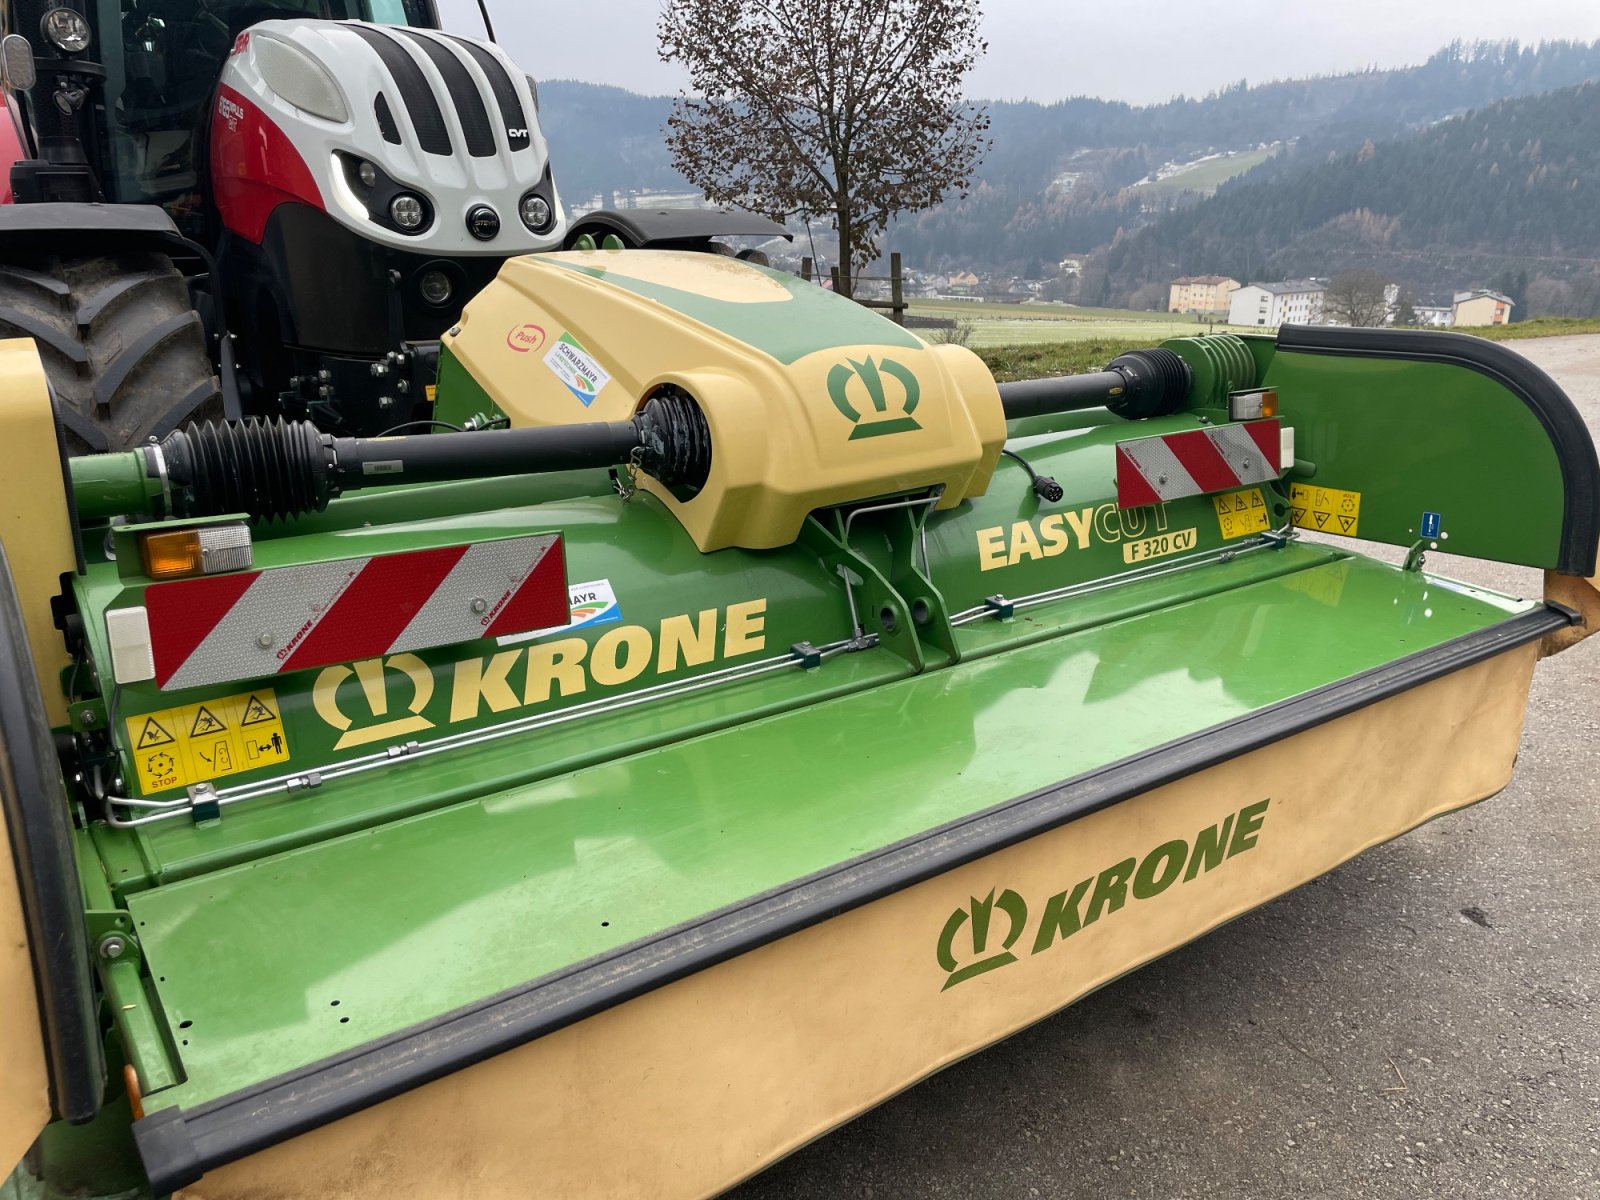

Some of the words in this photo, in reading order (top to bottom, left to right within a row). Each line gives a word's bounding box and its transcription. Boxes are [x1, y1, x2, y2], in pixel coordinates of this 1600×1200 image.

[508, 128, 528, 138] CVT
[515, 331, 537, 345] Push
[558, 343, 598, 384] SCHWARZMAYR
[1131, 547, 1140, 561] F
[1144, 539, 1169, 558] 320
[1172, 531, 1192, 550] CV
[489, 590, 512, 620] KRONE
[286, 619, 313, 652] KRONE
[449, 598, 767, 724] KRONE
[152, 776, 177, 789] STOP
[1030, 797, 1271, 956] KRONE
